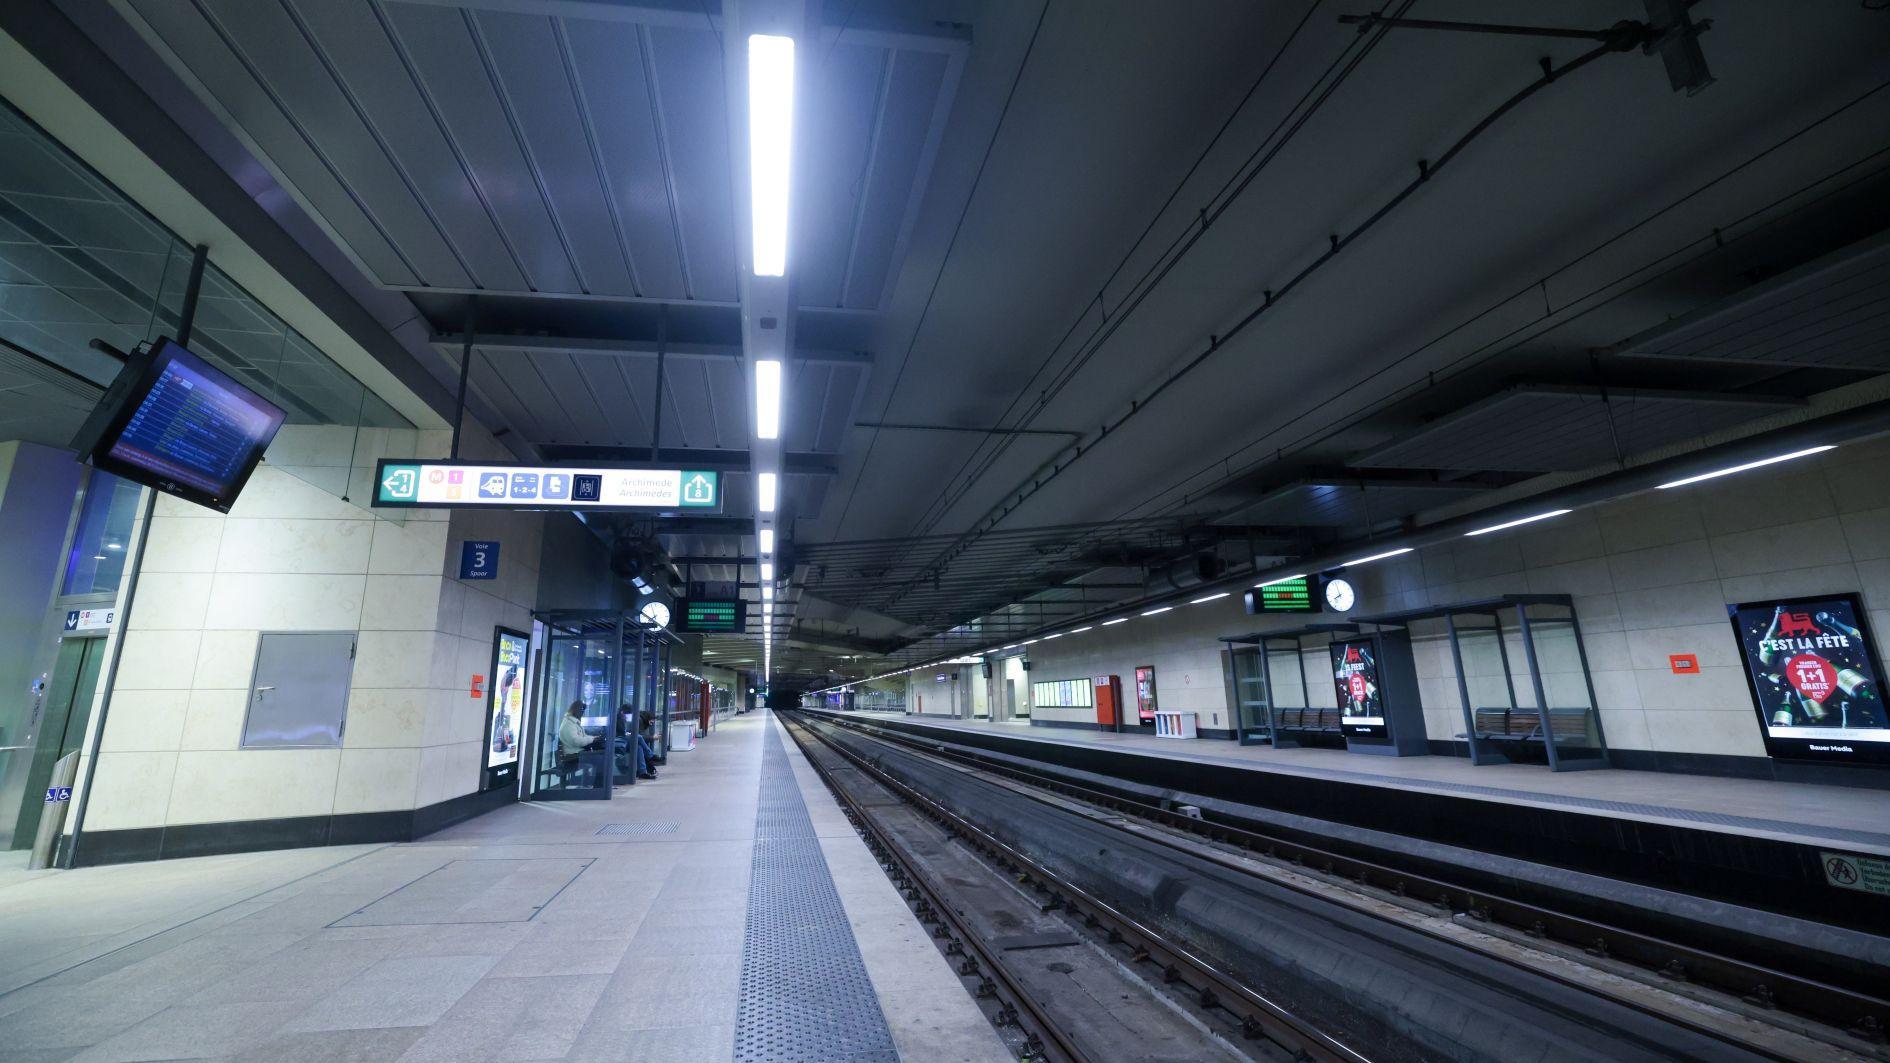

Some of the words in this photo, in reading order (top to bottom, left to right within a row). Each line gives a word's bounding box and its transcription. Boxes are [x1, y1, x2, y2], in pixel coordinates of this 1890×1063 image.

[622, 478, 672, 487] Archimede
[619, 489, 672, 498] Archimedes
[474, 552, 485, 568] 3
[1759, 638, 1794, 651] C'EST
[1797, 637, 1814, 650] LA
[1816, 632, 1850, 649] FÊTE
[1796, 669, 1826, 683] 1+1
